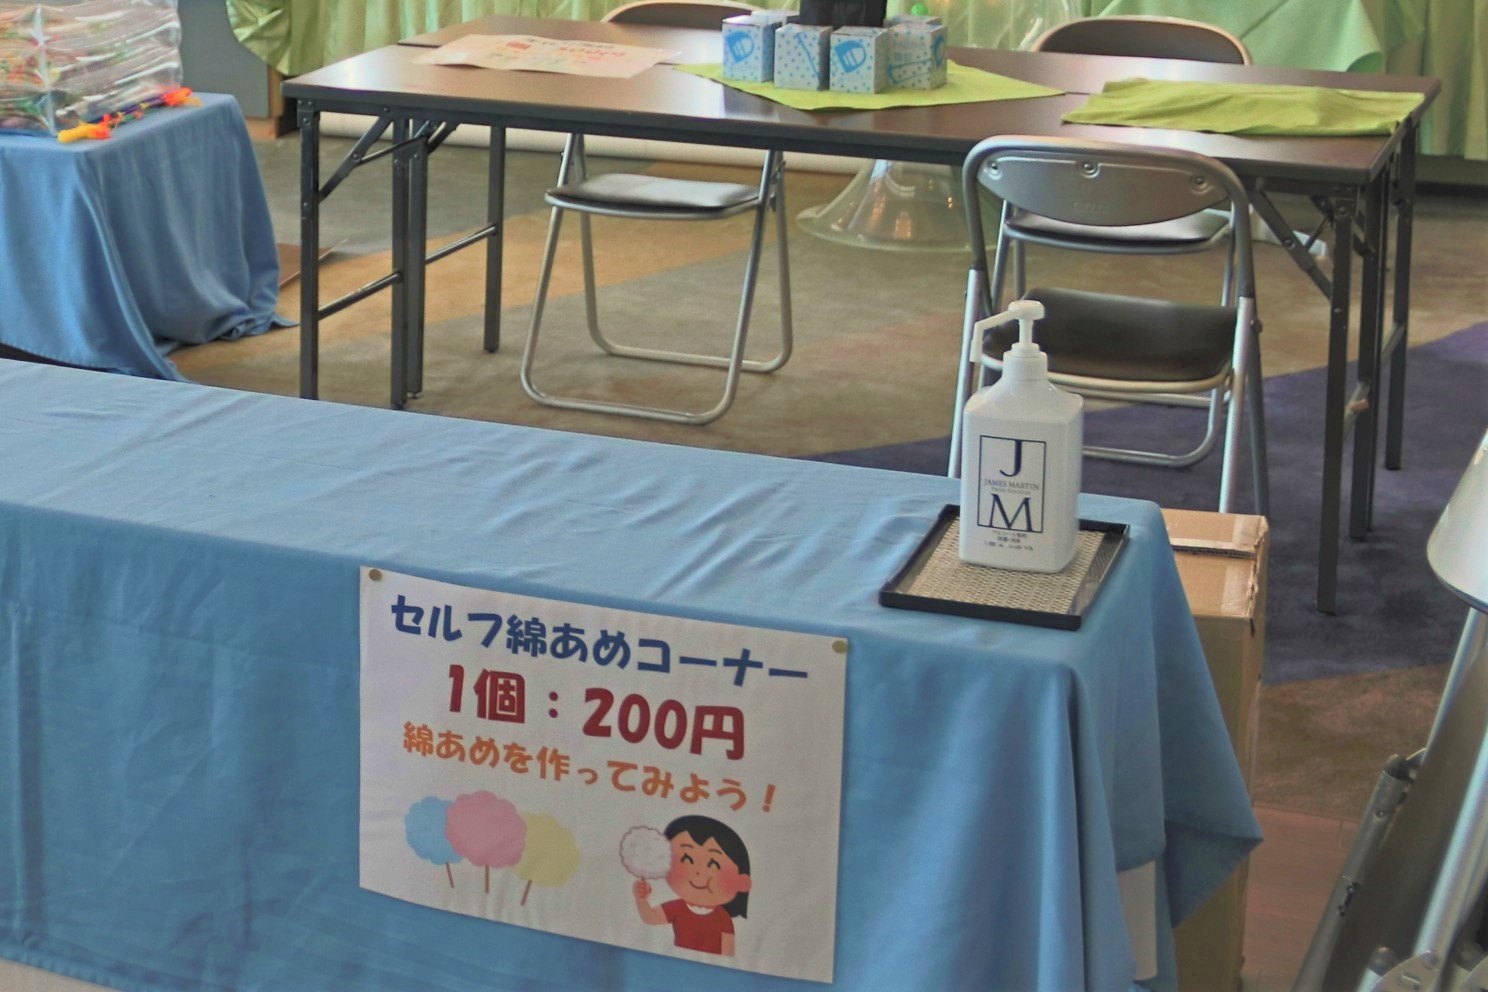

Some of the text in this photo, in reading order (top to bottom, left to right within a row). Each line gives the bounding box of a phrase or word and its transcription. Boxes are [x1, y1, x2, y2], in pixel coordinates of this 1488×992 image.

[999, 439, 1023, 477] J
[984, 478, 1007, 488] JAMES
[1009, 481, 1040, 491] MARTIN
[989, 493, 1034, 532] M
[390, 594, 809, 687] セルフ綿あめコーナー
[402, 721, 777, 813] 綿あめを作ってみよう！
